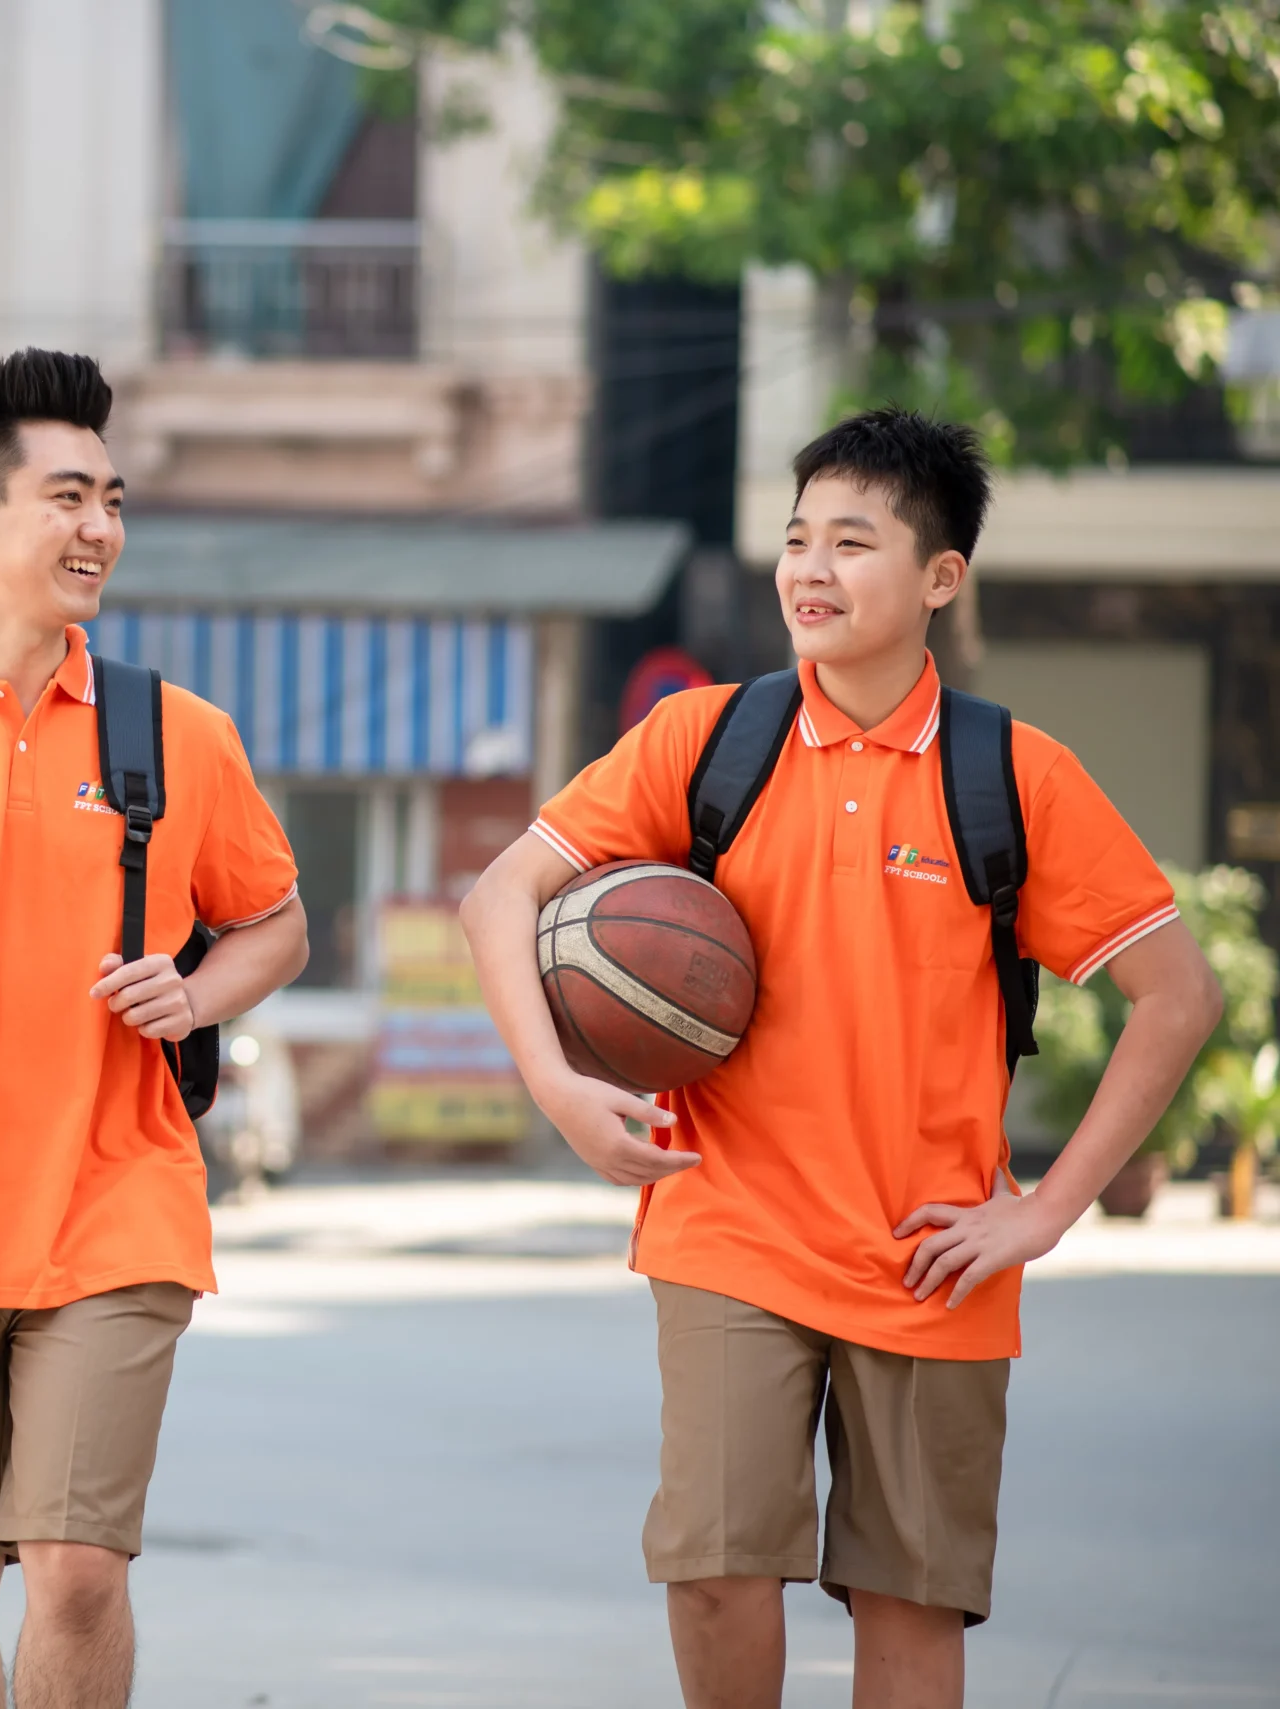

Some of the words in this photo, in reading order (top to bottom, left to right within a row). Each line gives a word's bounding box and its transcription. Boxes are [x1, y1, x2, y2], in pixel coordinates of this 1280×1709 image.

[78, 782, 105, 799] FPT
[73, 800, 92, 811] FPT
[888, 846, 918, 863] FPT
[884, 865, 902, 876] FPT
[903, 869, 948, 884] SCHOOLS
